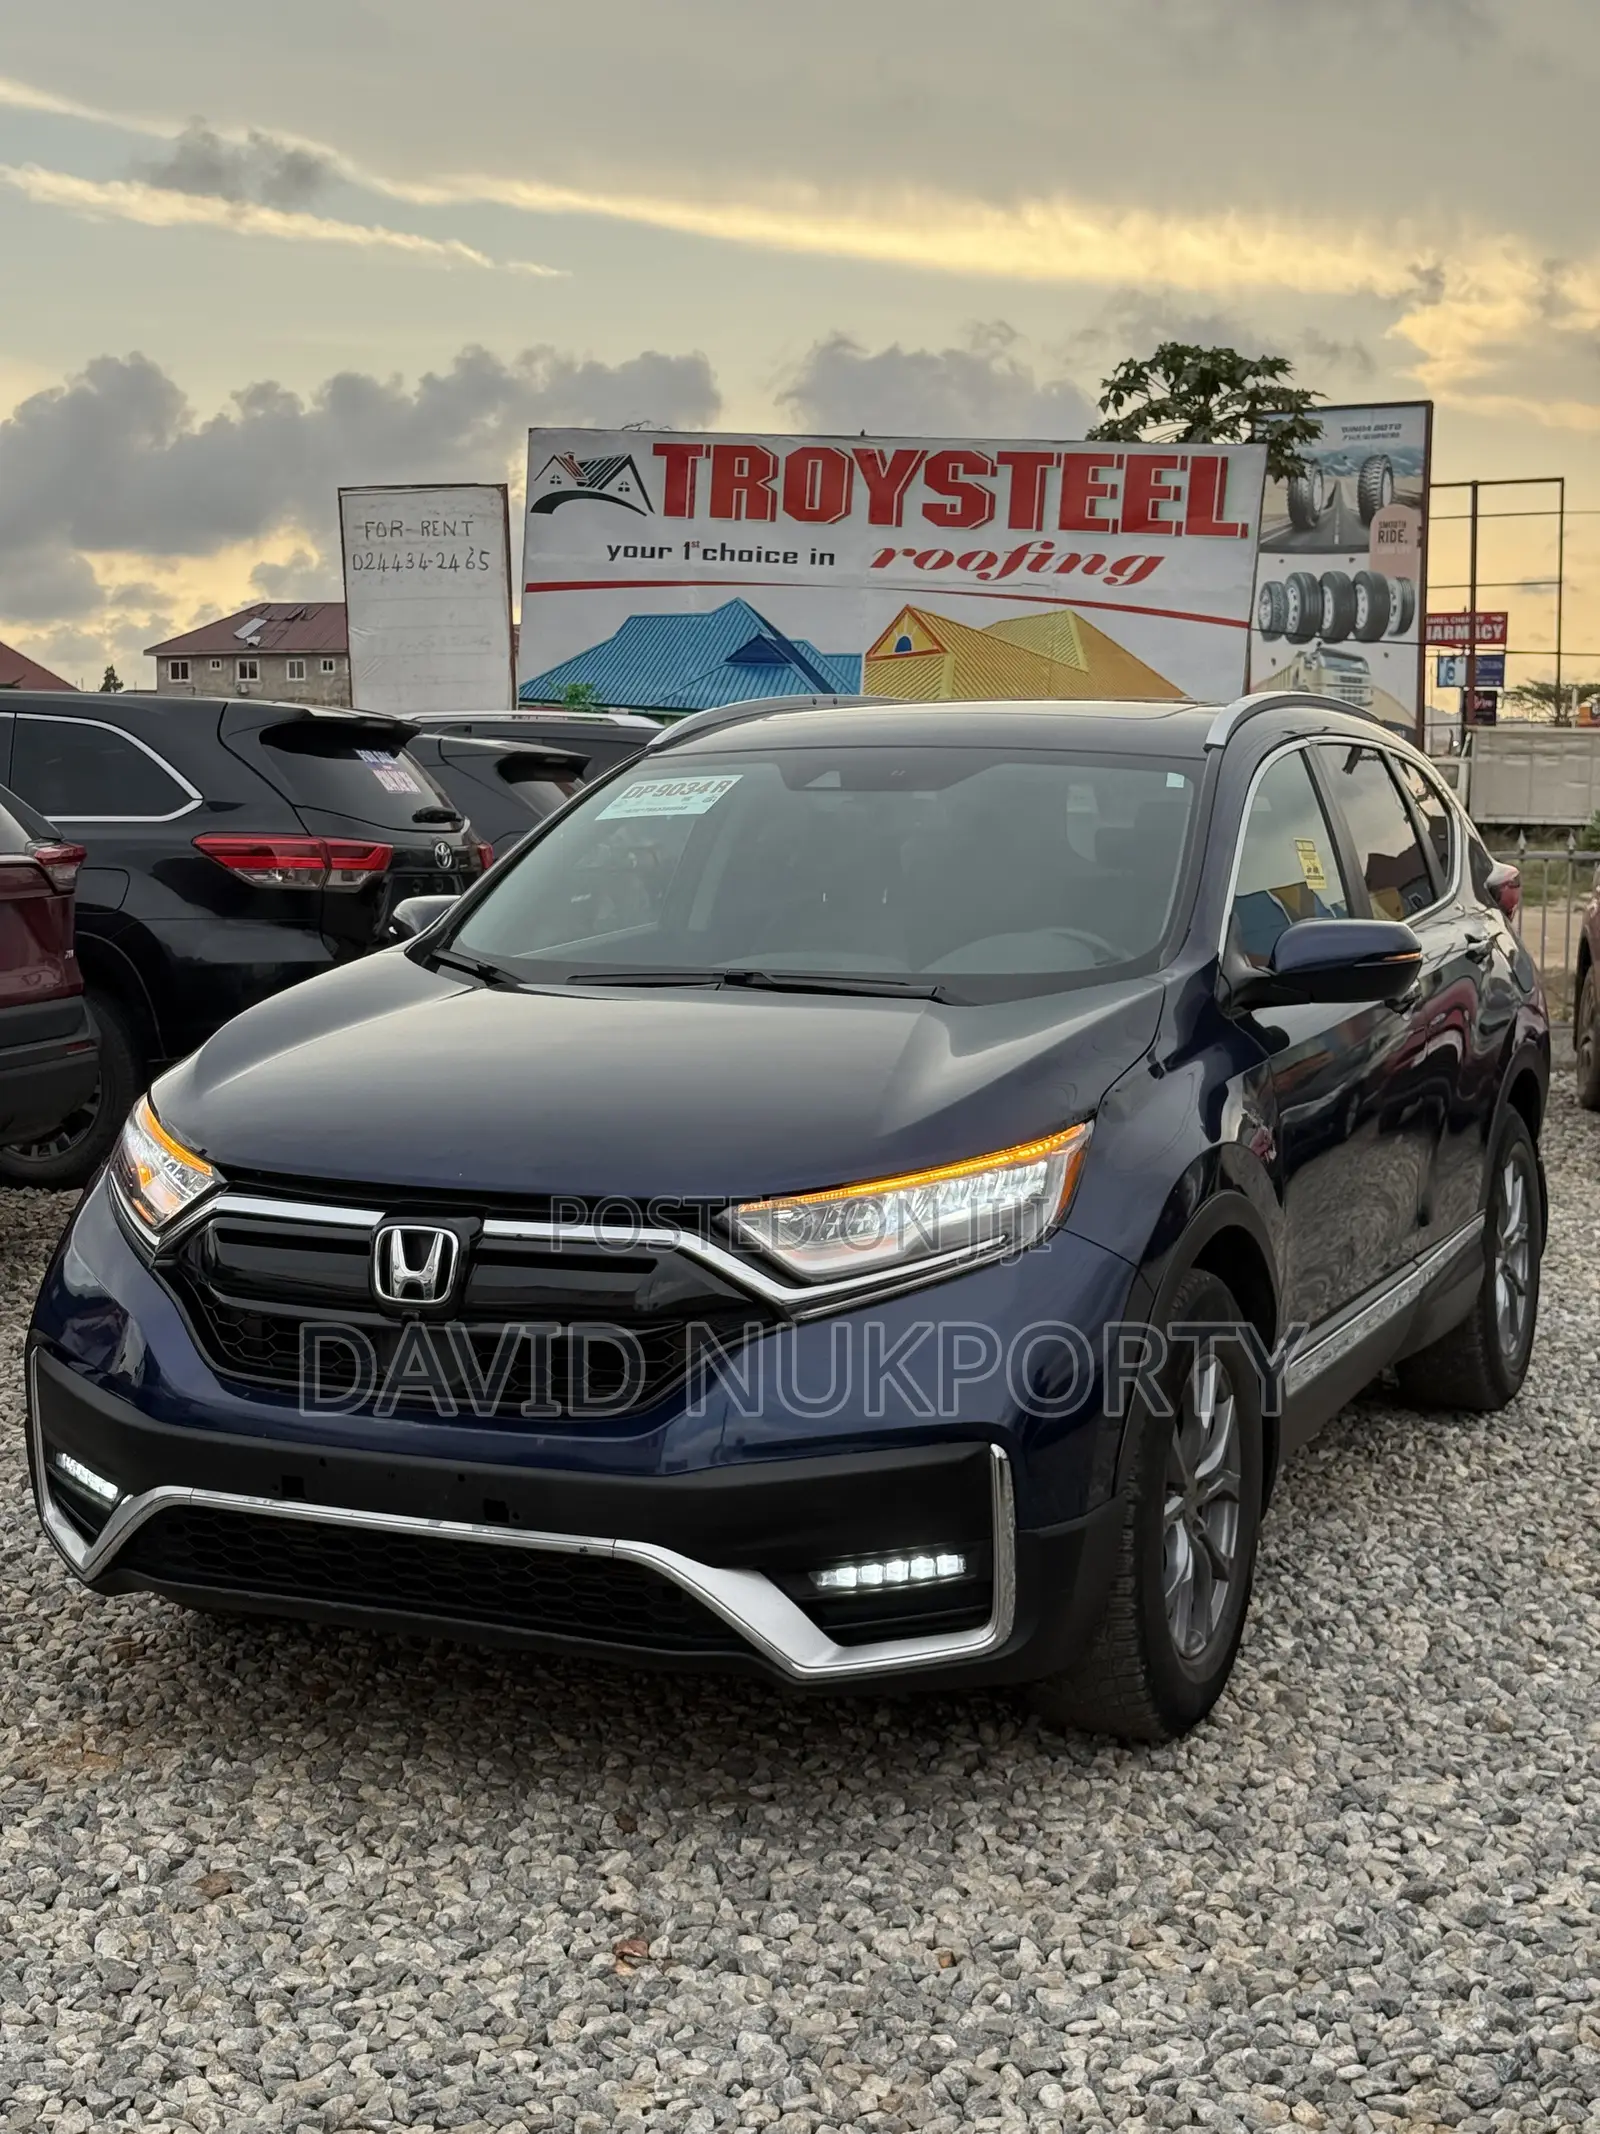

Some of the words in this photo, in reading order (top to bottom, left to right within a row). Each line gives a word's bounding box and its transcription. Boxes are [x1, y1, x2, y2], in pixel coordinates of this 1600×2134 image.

[652, 442, 1249, 539] TROYSTEEL
[606, 544, 673, 561] your
[701, 543, 799, 565] choice
[809, 548, 836, 566] in
[869, 540, 1166, 586] roofing
